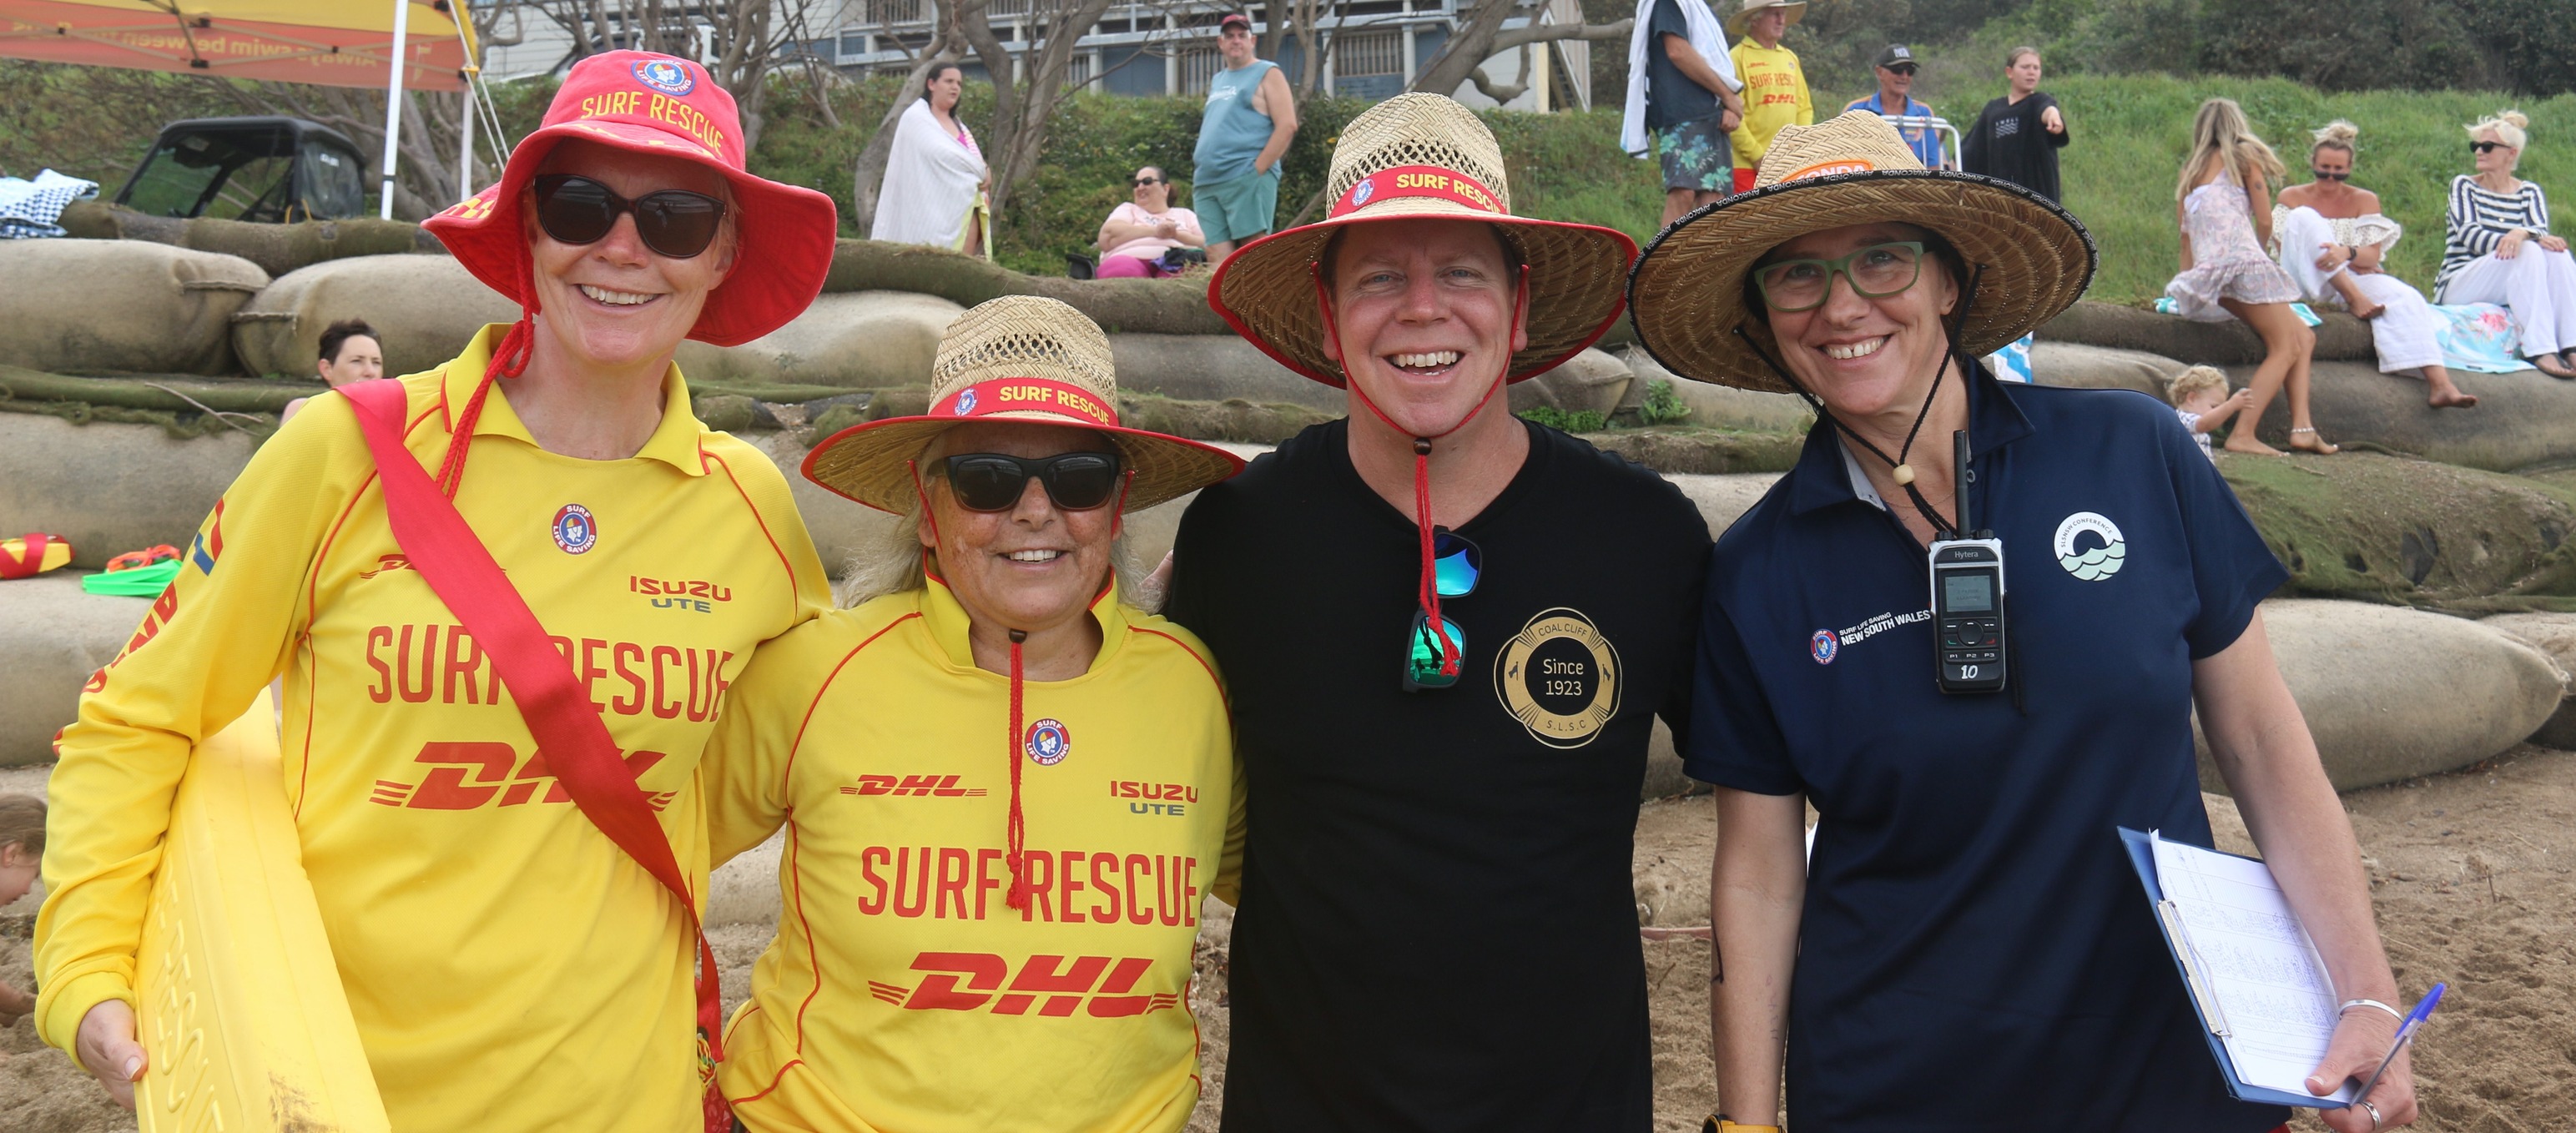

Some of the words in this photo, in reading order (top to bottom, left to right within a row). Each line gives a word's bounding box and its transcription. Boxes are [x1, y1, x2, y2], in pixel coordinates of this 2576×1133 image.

[658, 78, 692, 93] SAVING
[1749, 73, 1772, 89] SURF
[581, 91, 643, 119] SURF
[650, 93, 723, 157] RESCUE
[1396, 174, 1449, 190] SURF
[1823, 170, 1873, 182] ANACONDA
[1939, 170, 1984, 181] ANACONDA
[1767, 177, 1815, 192] ANACONDA
[1989, 178, 2028, 194] ANACONDA
[1716, 189, 1760, 207] ANACONDA
[1675, 204, 1711, 225] ANACONDA
[1000, 386, 1052, 401] SURF
[1057, 390, 1109, 426] RESCUE
[567, 505, 591, 517] SURF
[553, 526, 566, 547] LIFE
[567, 535, 596, 552] SAVING
[2061, 524, 2074, 547] SLSNSW
[2073, 518, 2113, 534] CONFERENCE
[1954, 551, 1979, 559] Hytera
[630, 576, 732, 602] ISUZU
[651, 598, 711, 613] UTE
[1538, 623, 1562, 637] COAL
[1564, 623, 1588, 637] CLIFF
[1839, 627, 1858, 636] SURF
[1858, 620, 1869, 630] LIFE
[1868, 612, 1892, 624] SAVING
[1841, 630, 1864, 646] NEW
[1864, 619, 1895, 638] SOUTH
[1895, 609, 1931, 625] WALES
[1543, 658, 1584, 675] Since
[1961, 665, 1979, 679] 10
[1545, 681, 1582, 696] 1923
[1036, 720, 1062, 729] SURF
[1026, 743, 1040, 761] LIFE
[1042, 743, 1069, 765] SAVING
[857, 775, 967, 796] DHL
[1111, 781, 1197, 803] ISUZU
[1130, 803, 1185, 816] UTE
[858, 846, 1001, 920] SURF
[1021, 849, 1197, 928] RESCUE
[904, 952, 1154, 1018] DHL
